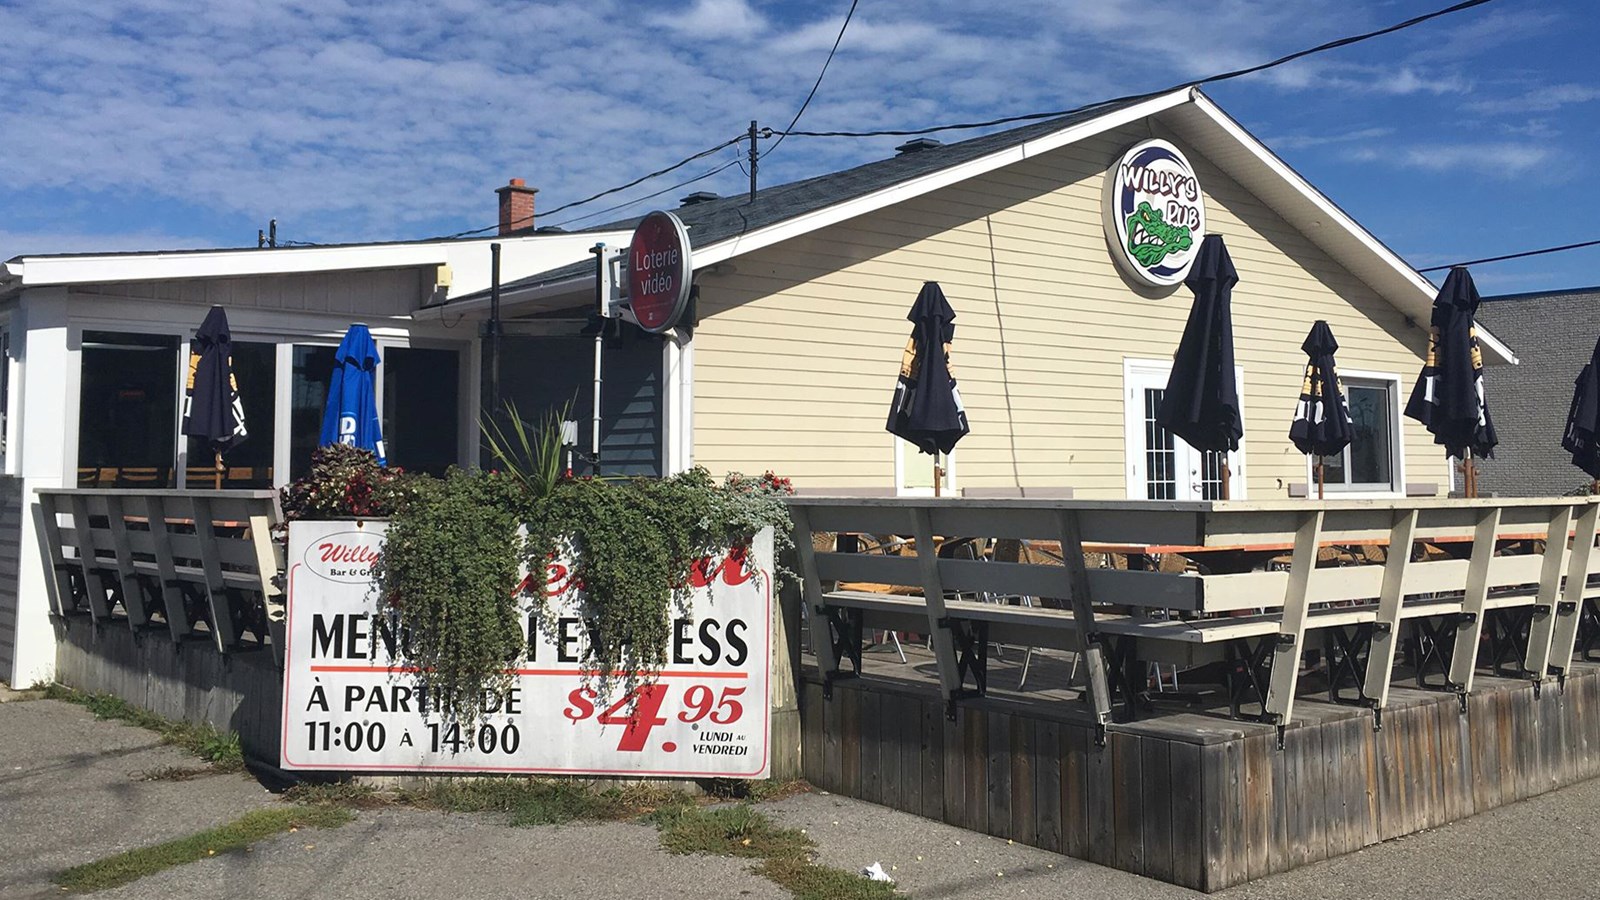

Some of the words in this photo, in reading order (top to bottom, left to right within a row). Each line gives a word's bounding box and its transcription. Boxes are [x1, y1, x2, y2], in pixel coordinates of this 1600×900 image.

[1122, 164, 1197, 201] WILLY'S
[1166, 200, 1200, 231] PUB
[636, 245, 678, 271] Loterie
[641, 271, 672, 295] vidéo
[330, 568, 346, 576] Bar
[349, 568, 358, 576] &
[557, 617, 748, 667] EXESS
[306, 677, 329, 712] À
[480, 687, 521, 715] DE
[305, 721, 386, 752] 11:00
[400, 728, 413, 747] À
[692, 744, 748, 756] VENDREDI
[699, 732, 733, 742] LUNDI
